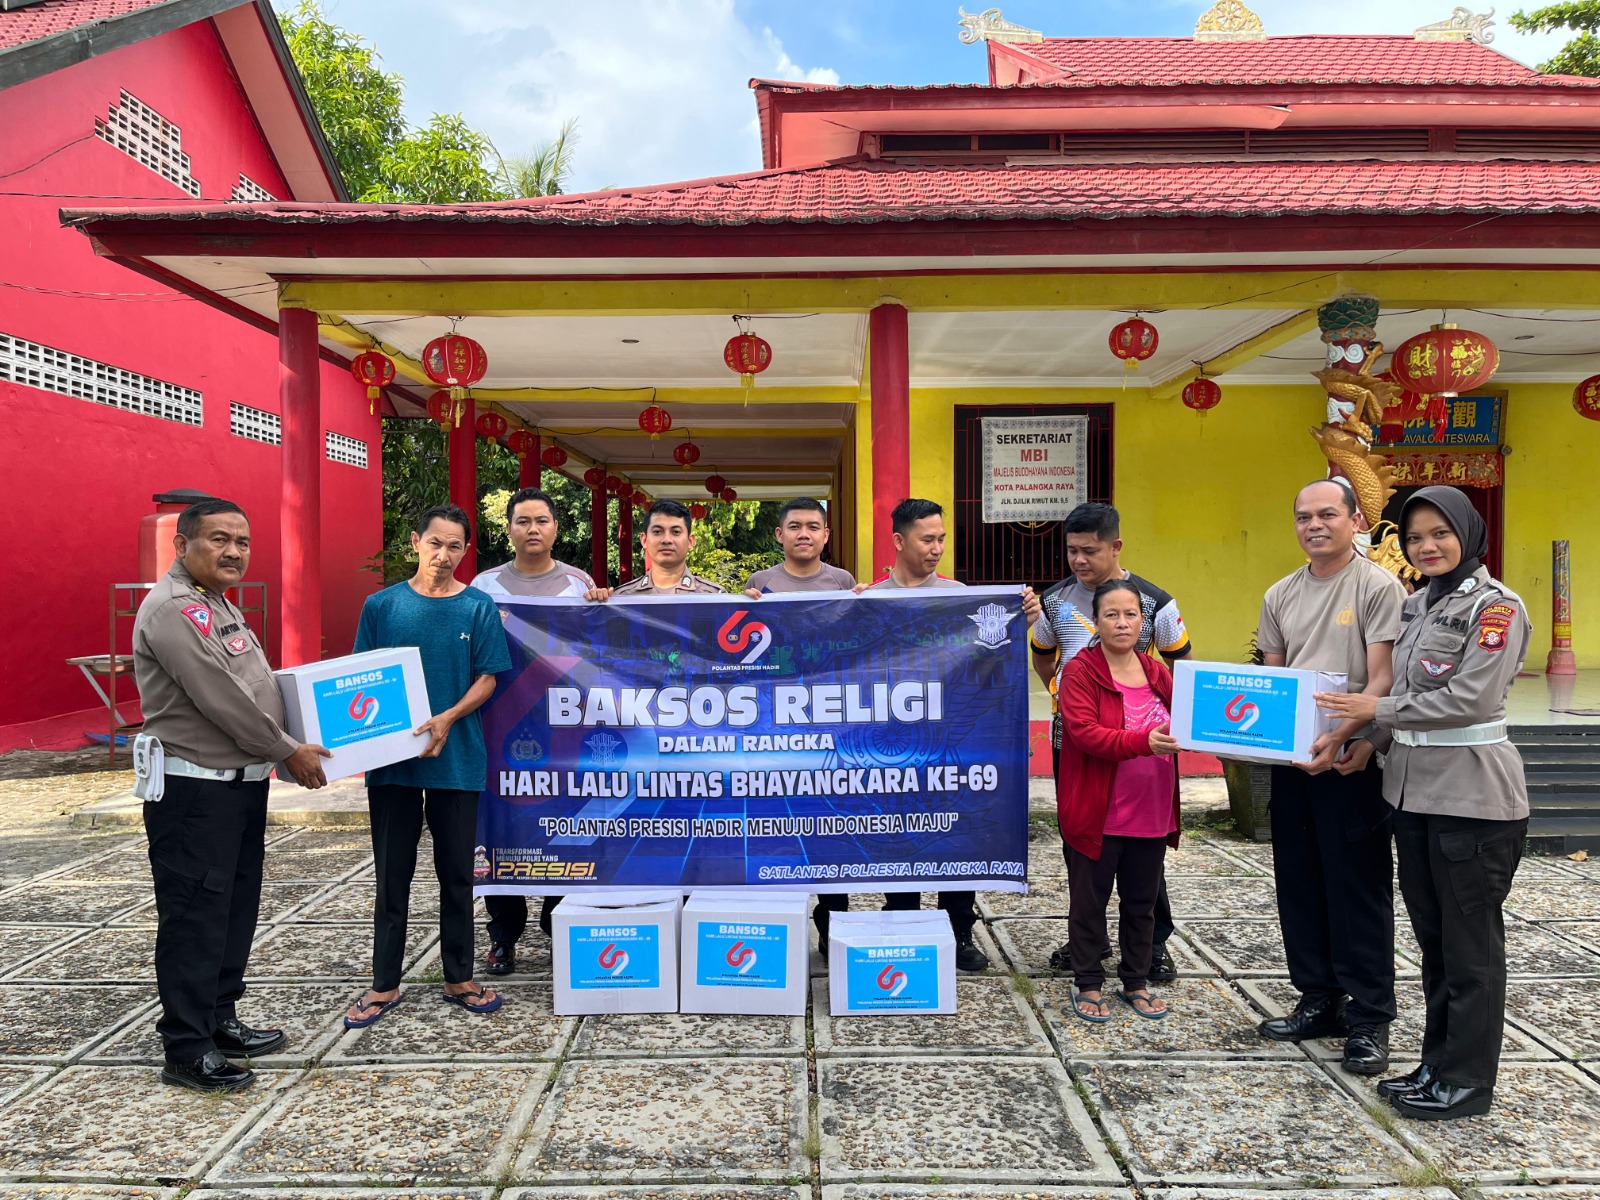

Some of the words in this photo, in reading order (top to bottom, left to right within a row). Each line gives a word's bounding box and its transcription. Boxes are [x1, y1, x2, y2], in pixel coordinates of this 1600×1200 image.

[996, 433, 1072, 445] SEKRETARIAT
[1403, 433, 1490, 444] AVALOTESVARA
[1020, 448, 1049, 462] MBI
[993, 467, 1014, 478] MAJELIS
[1014, 466, 1048, 477] BUDDHAYANA
[1049, 466, 1075, 476] INDONESIA
[335, 671, 383, 689] BANSOS
[1217, 674, 1272, 689] BANSOS
[547, 685, 758, 727] BAKSOS
[774, 681, 942, 725] RELIGI
[658, 735, 736, 753] DALAM
[742, 733, 835, 751] RANGKA
[499, 770, 559, 796] HARI
[567, 771, 629, 798] LALU
[636, 772, 723, 798] LINTAS
[731, 767, 920, 797] BHAYANGKARA
[927, 764, 998, 792] KE-69
[630, 818, 689, 838] PRESISI
[692, 818, 743, 838] HADIR
[747, 816, 814, 837] MENUJU
[817, 814, 904, 836] INDONESIA
[496, 862, 596, 876] PRESISI
[758, 864, 838, 880] SATLANTAS
[840, 863, 911, 878] POLRESTA
[913, 861, 988, 876] PALANGKA
[990, 861, 1024, 876] RAYA
[590, 927, 637, 937] BANSOS
[719, 924, 766, 936] BANSOS
[868, 948, 916, 958] BANSOS
